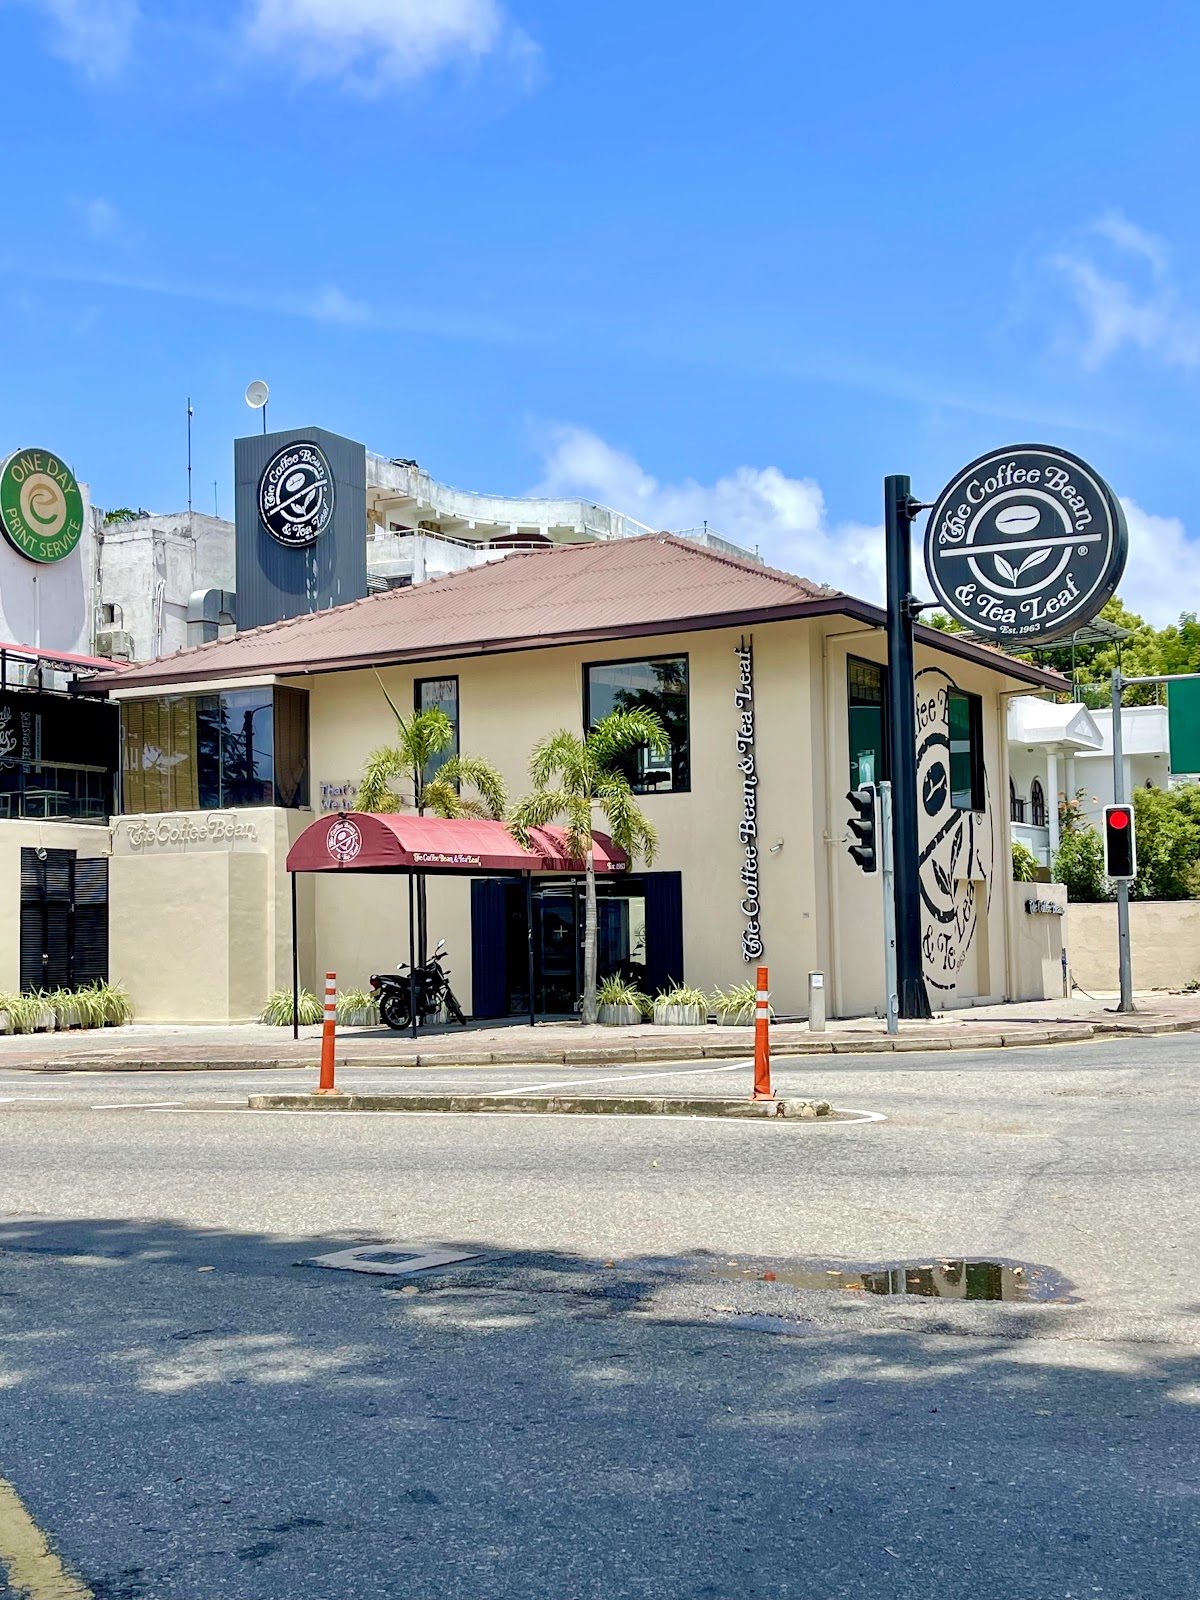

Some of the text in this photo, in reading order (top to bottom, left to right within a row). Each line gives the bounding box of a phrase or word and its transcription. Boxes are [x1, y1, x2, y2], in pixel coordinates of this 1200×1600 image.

[11, 454, 76, 494] ONE DAY
[269, 454, 299, 484] Coffee
[299, 449, 326, 479] Bean
[938, 462, 1093, 545] The Coffee Bean
[5, 507, 80, 558] PRINT SERVICE
[282, 522, 292, 536] &
[955, 572, 1081, 623] & Tea Leaf
[1000, 623, 1041, 634] Est. 1963
[733, 646, 763, 963] The Coffee Bean & Tea Leaf
[126, 819, 258, 846] The Coffee Bean
[936, 932, 956, 970] Te
